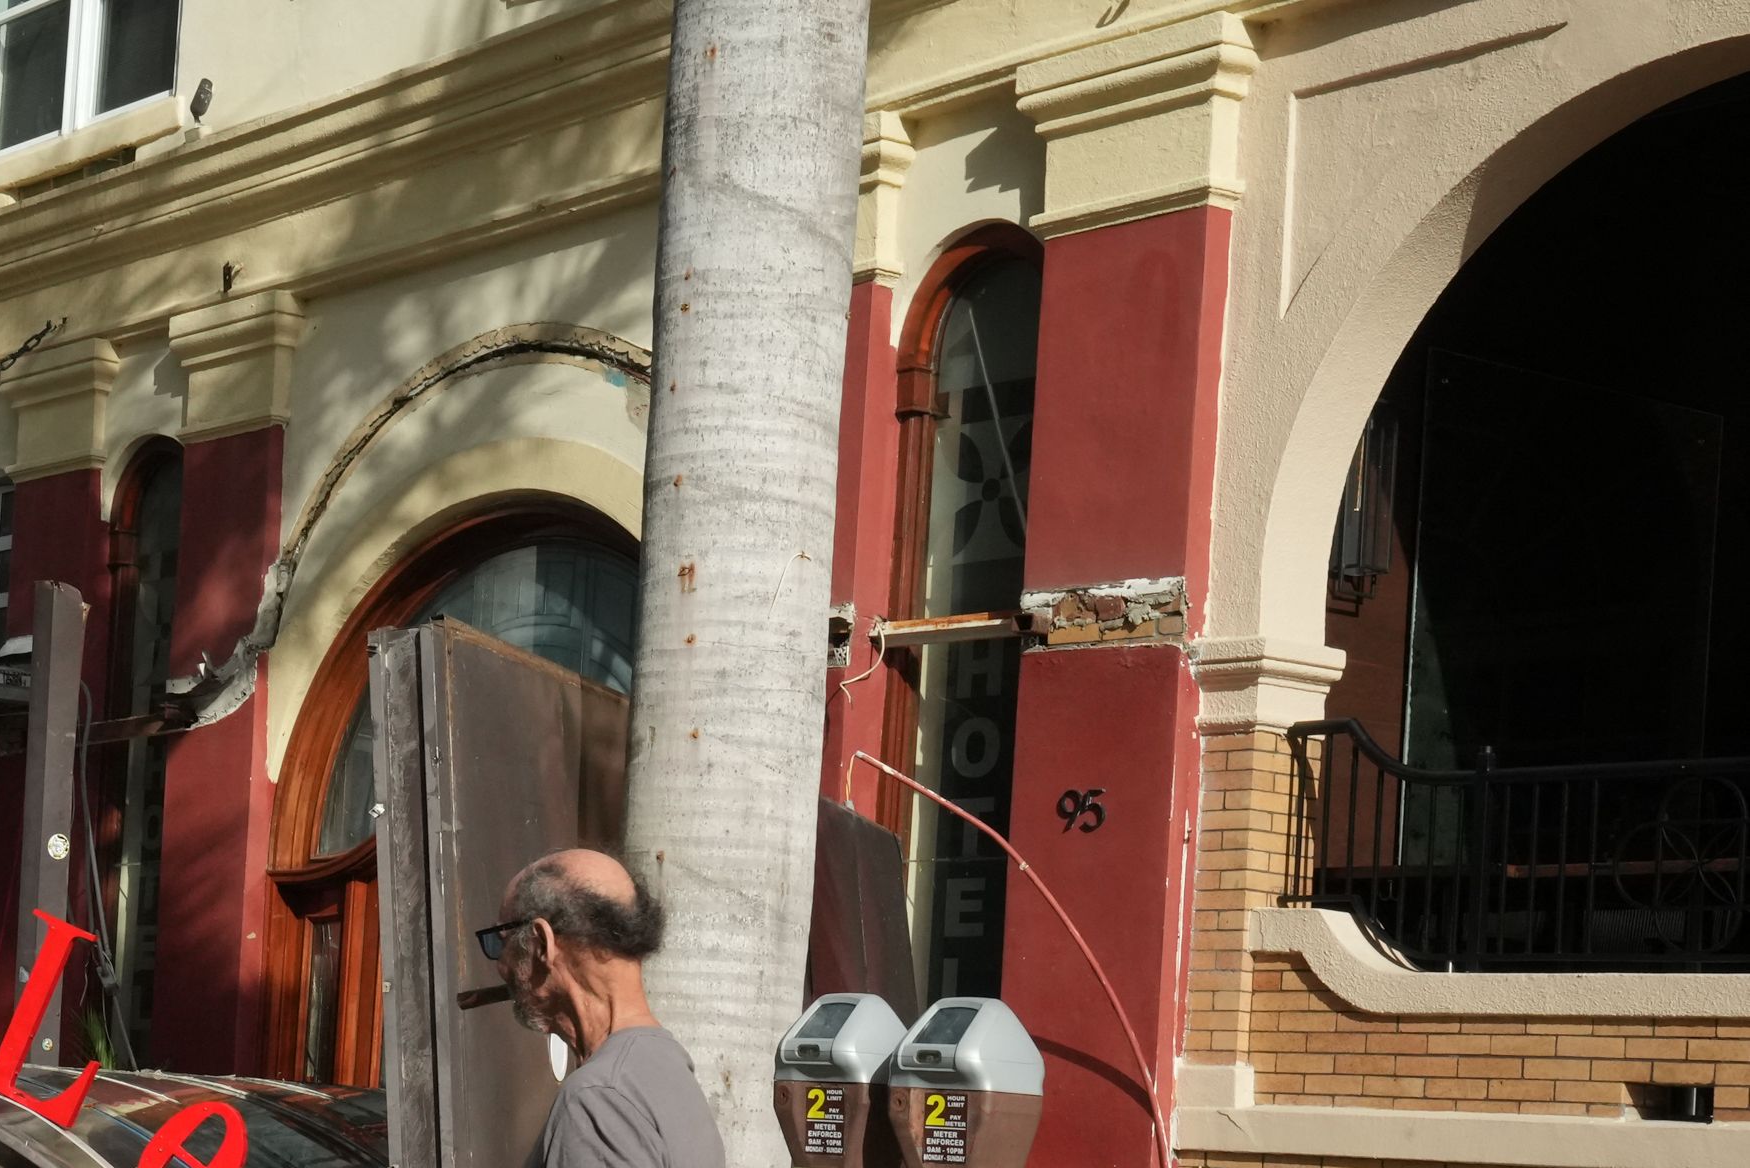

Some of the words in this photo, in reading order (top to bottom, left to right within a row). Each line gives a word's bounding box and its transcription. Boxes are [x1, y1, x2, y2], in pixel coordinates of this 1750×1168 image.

[1056, 788, 1106, 833] 95
[807, 1089, 825, 1118] 2
[926, 1095, 945, 1125] 2
[808, 1130, 842, 1138] ENFORCED
[926, 1138, 964, 1146] ENFORCED
